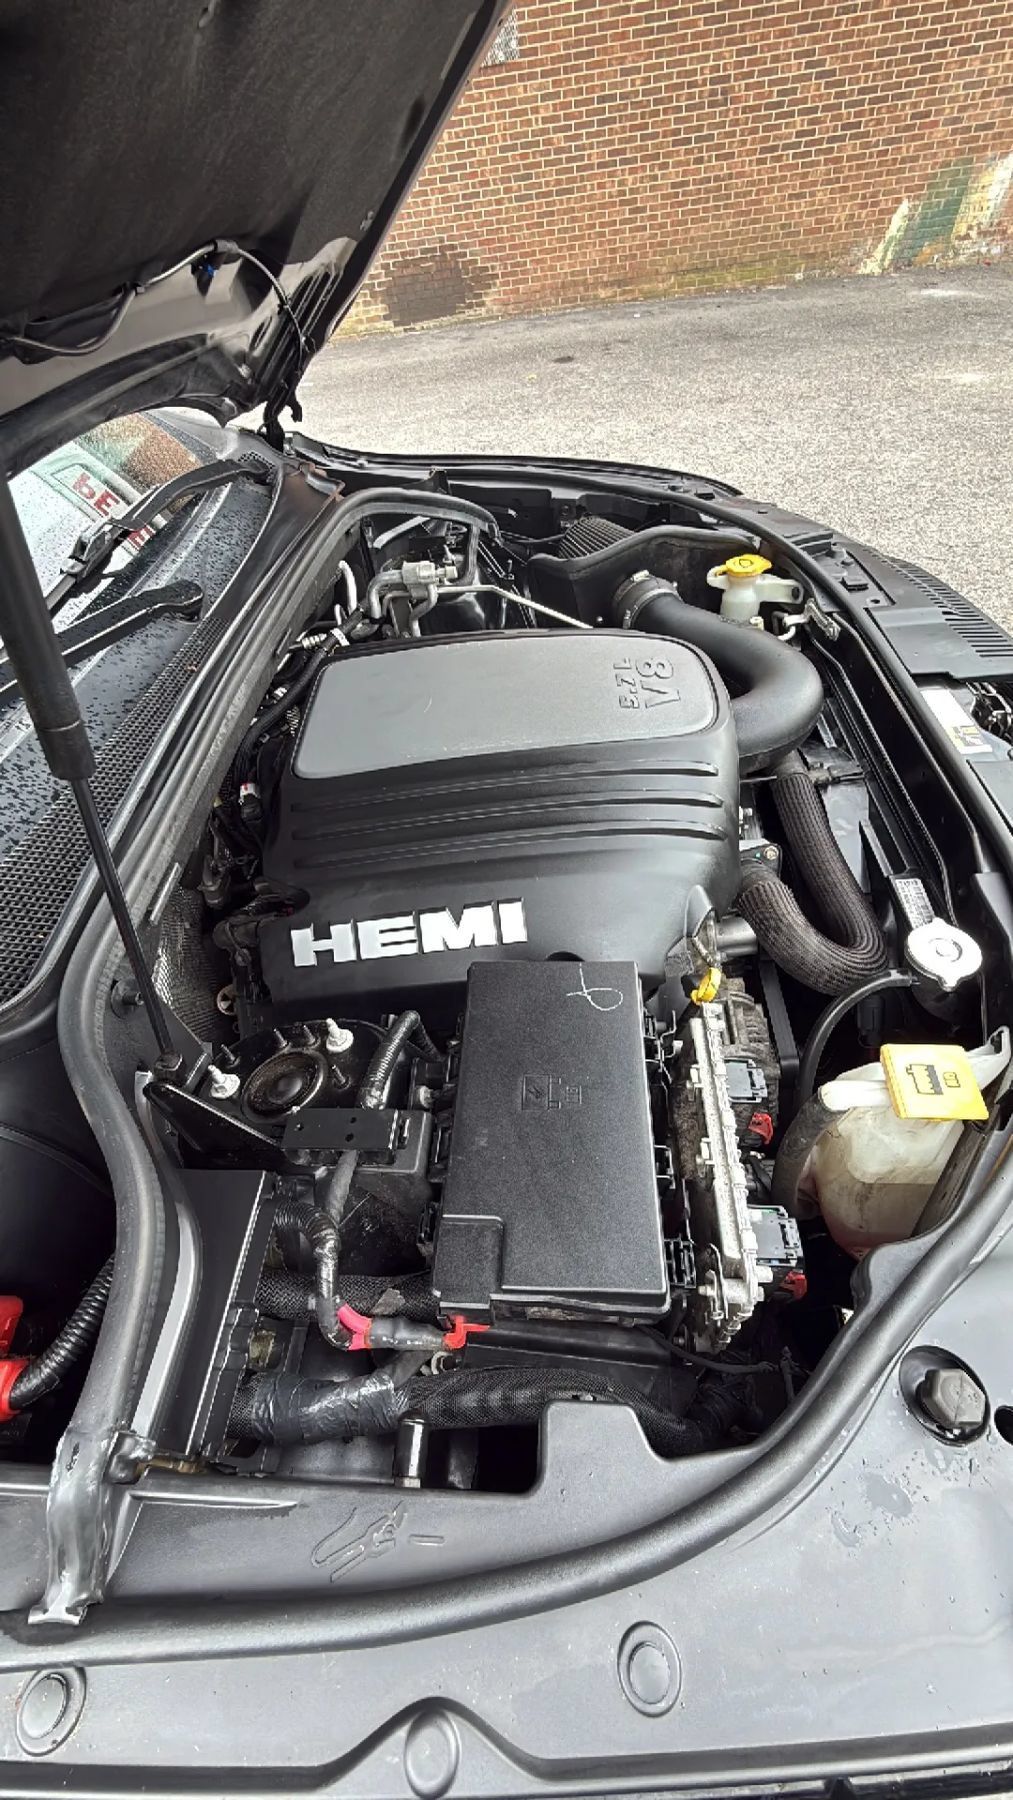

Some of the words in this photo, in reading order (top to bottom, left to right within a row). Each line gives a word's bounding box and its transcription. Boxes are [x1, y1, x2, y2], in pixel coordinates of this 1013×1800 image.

[613, 657, 640, 709] 5.7L
[635, 655, 681, 709] V8
[290, 897, 528, 967] HEMI
